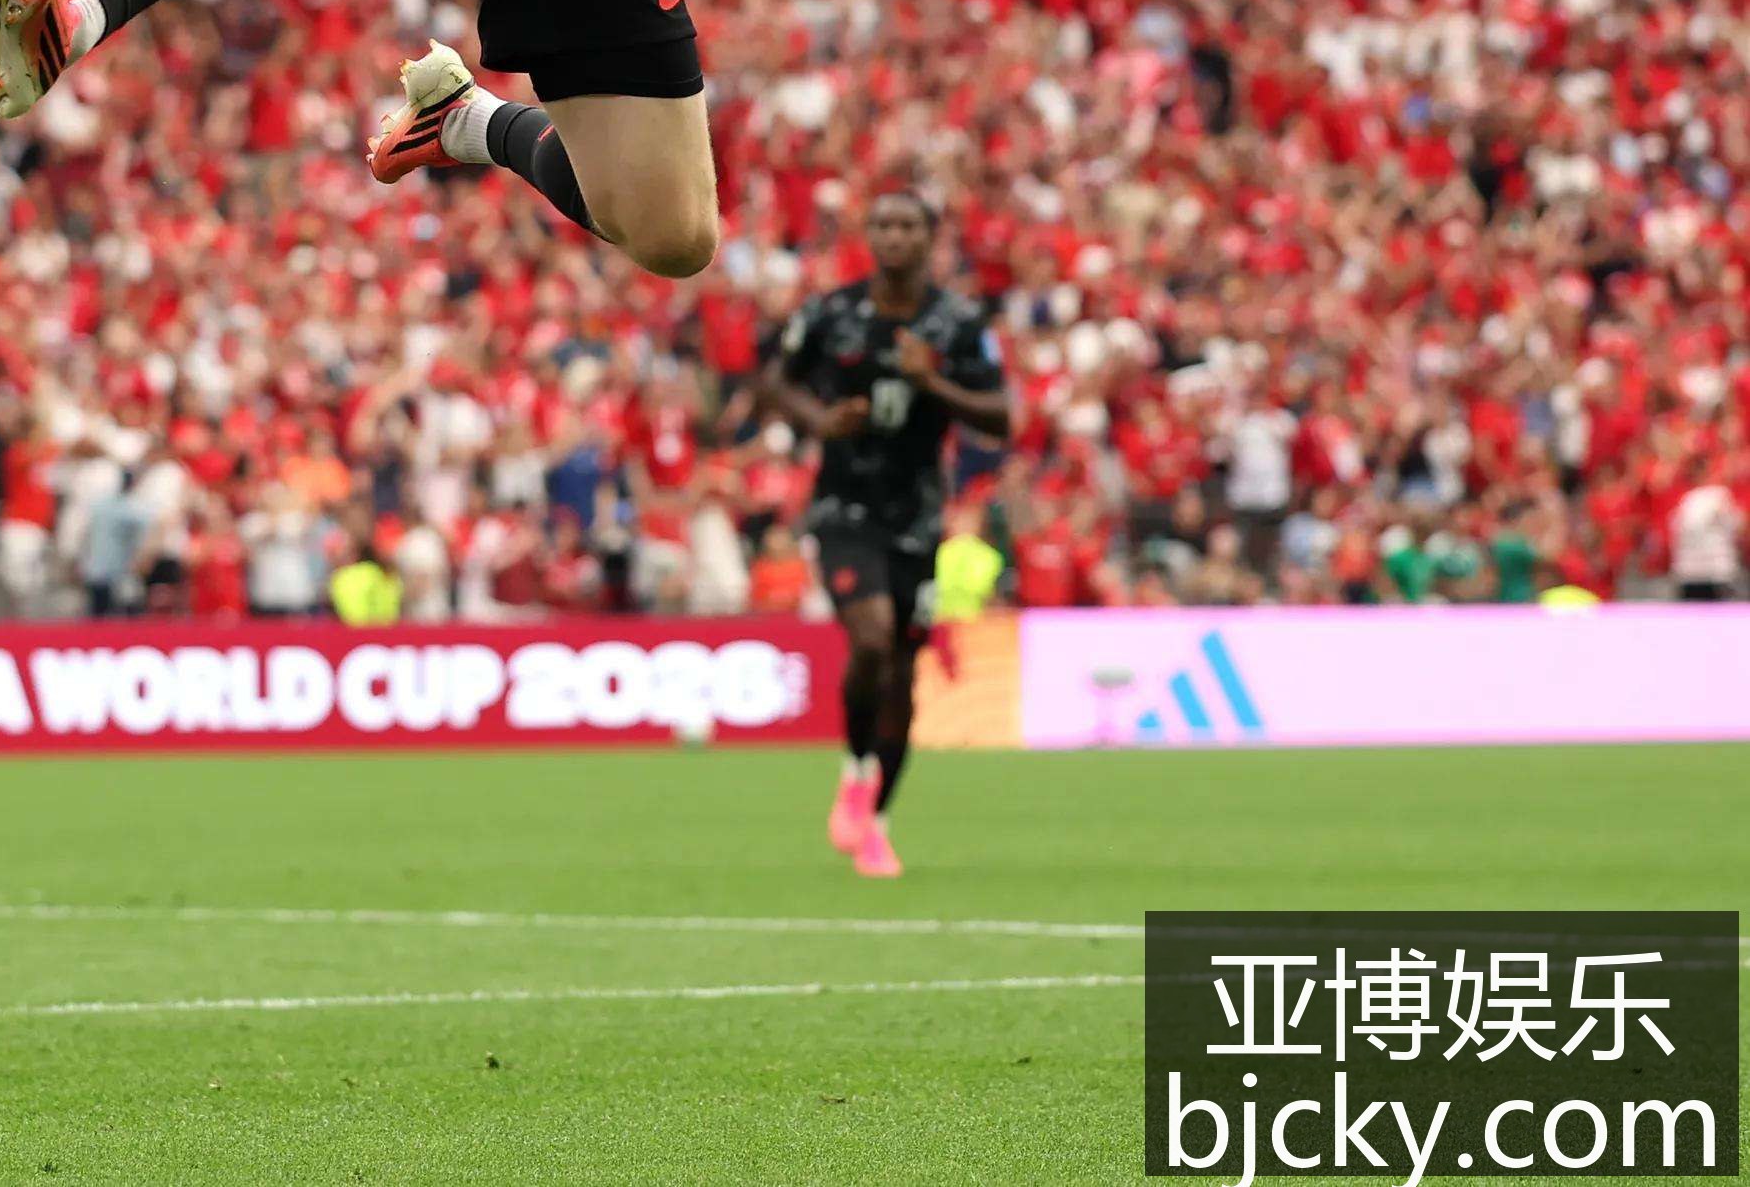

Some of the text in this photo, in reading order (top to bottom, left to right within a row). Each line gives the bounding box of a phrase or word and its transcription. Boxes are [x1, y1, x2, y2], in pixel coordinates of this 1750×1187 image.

[30, 644, 335, 734] WORLD
[337, 643, 505, 732] CUP
[506, 639, 788, 729] 2026
